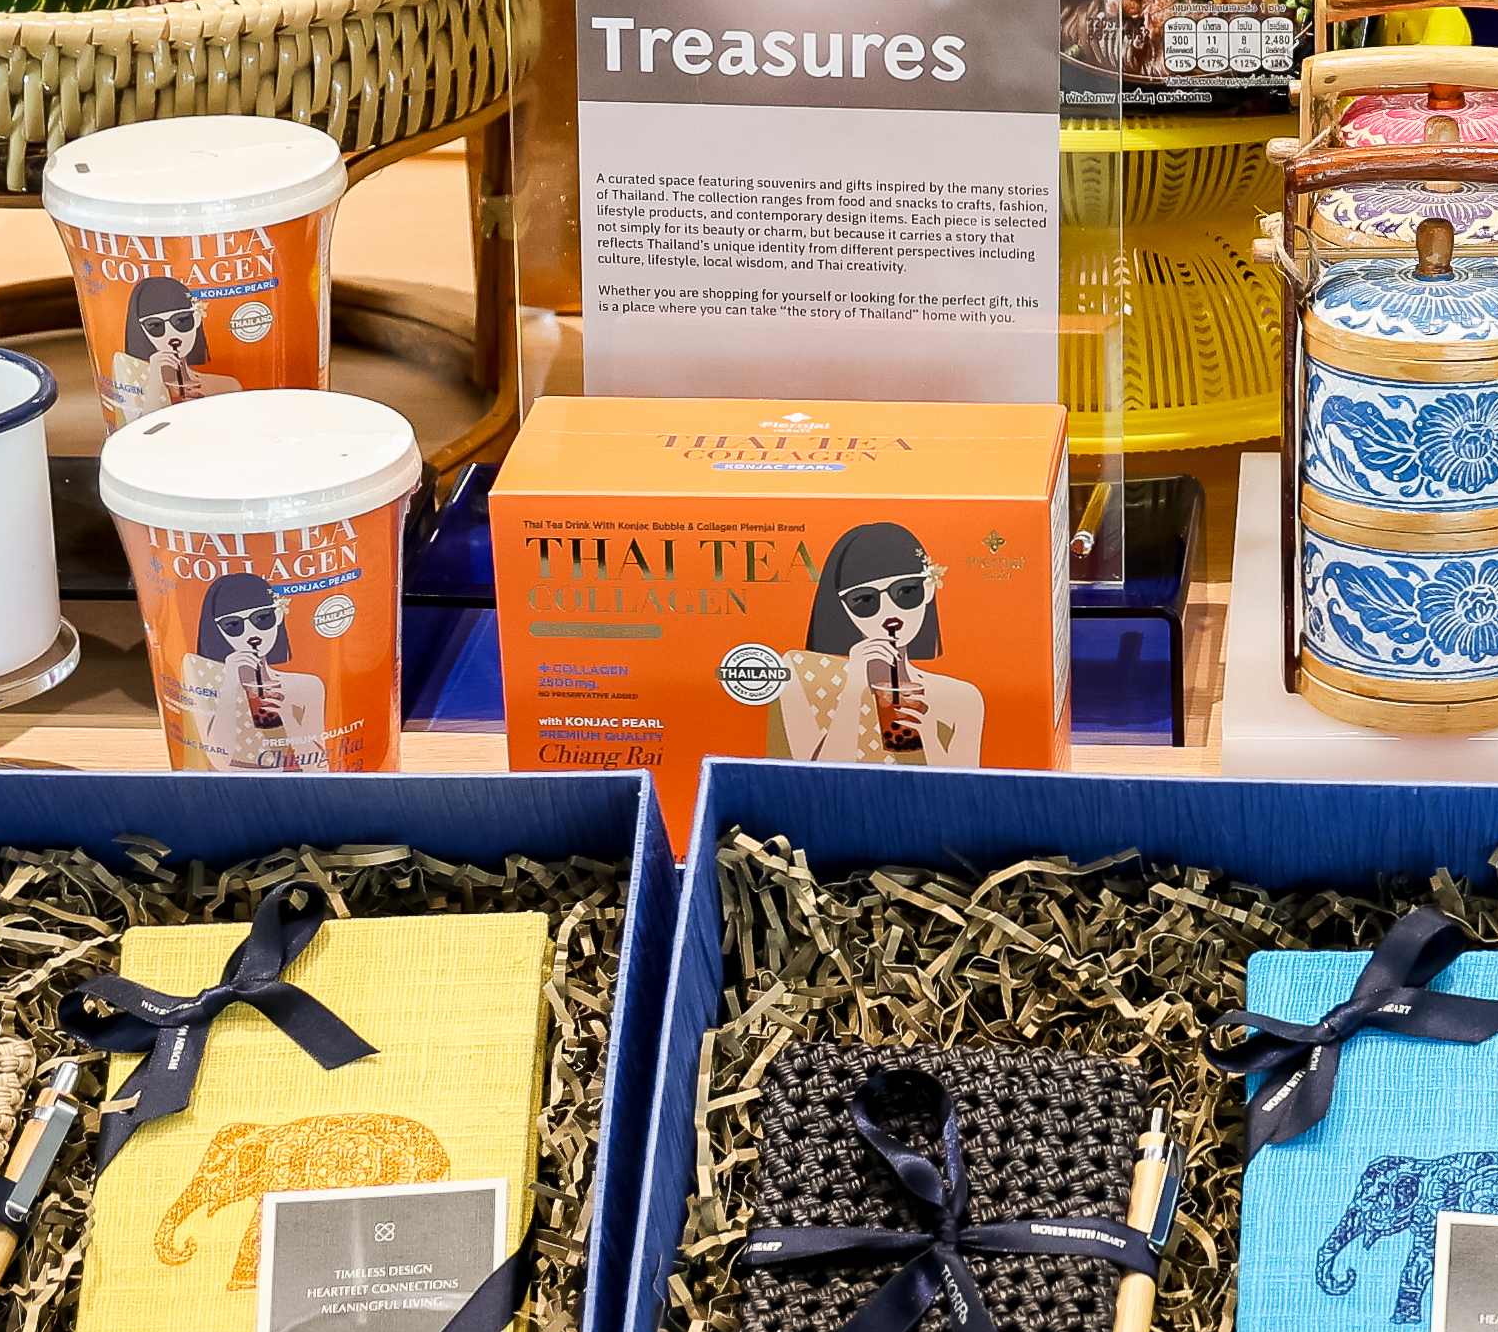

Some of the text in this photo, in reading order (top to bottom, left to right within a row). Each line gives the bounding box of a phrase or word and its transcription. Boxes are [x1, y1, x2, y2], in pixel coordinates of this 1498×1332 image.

[591, 16, 967, 83] Treasures
[595, 171, 1050, 198] A curated space featuring souvenirs and gifts inspired by the many stories
[101, 252, 274, 285] COLLAGEN
[200, 281, 274, 299] KONJAC PEARL
[657, 435, 913, 451] THAI TEA
[683, 450, 882, 462] COLLAGEN
[526, 537, 821, 583] THAI TEA
[283, 572, 358, 593] KONJAC PEARL
[528, 585, 748, 615] COLLAGEN
[720, 668, 787, 681] THAILAND
[320, 718, 365, 740] QUALITY
[539, 743, 664, 770] Chiang Rai
[334, 1263, 434, 1280] TIMELESS DESIGN
[306, 1278, 459, 1299] HEARTFELT CONNECTIONS
[320, 1295, 443, 1315] MEANINGFUL LIVING
